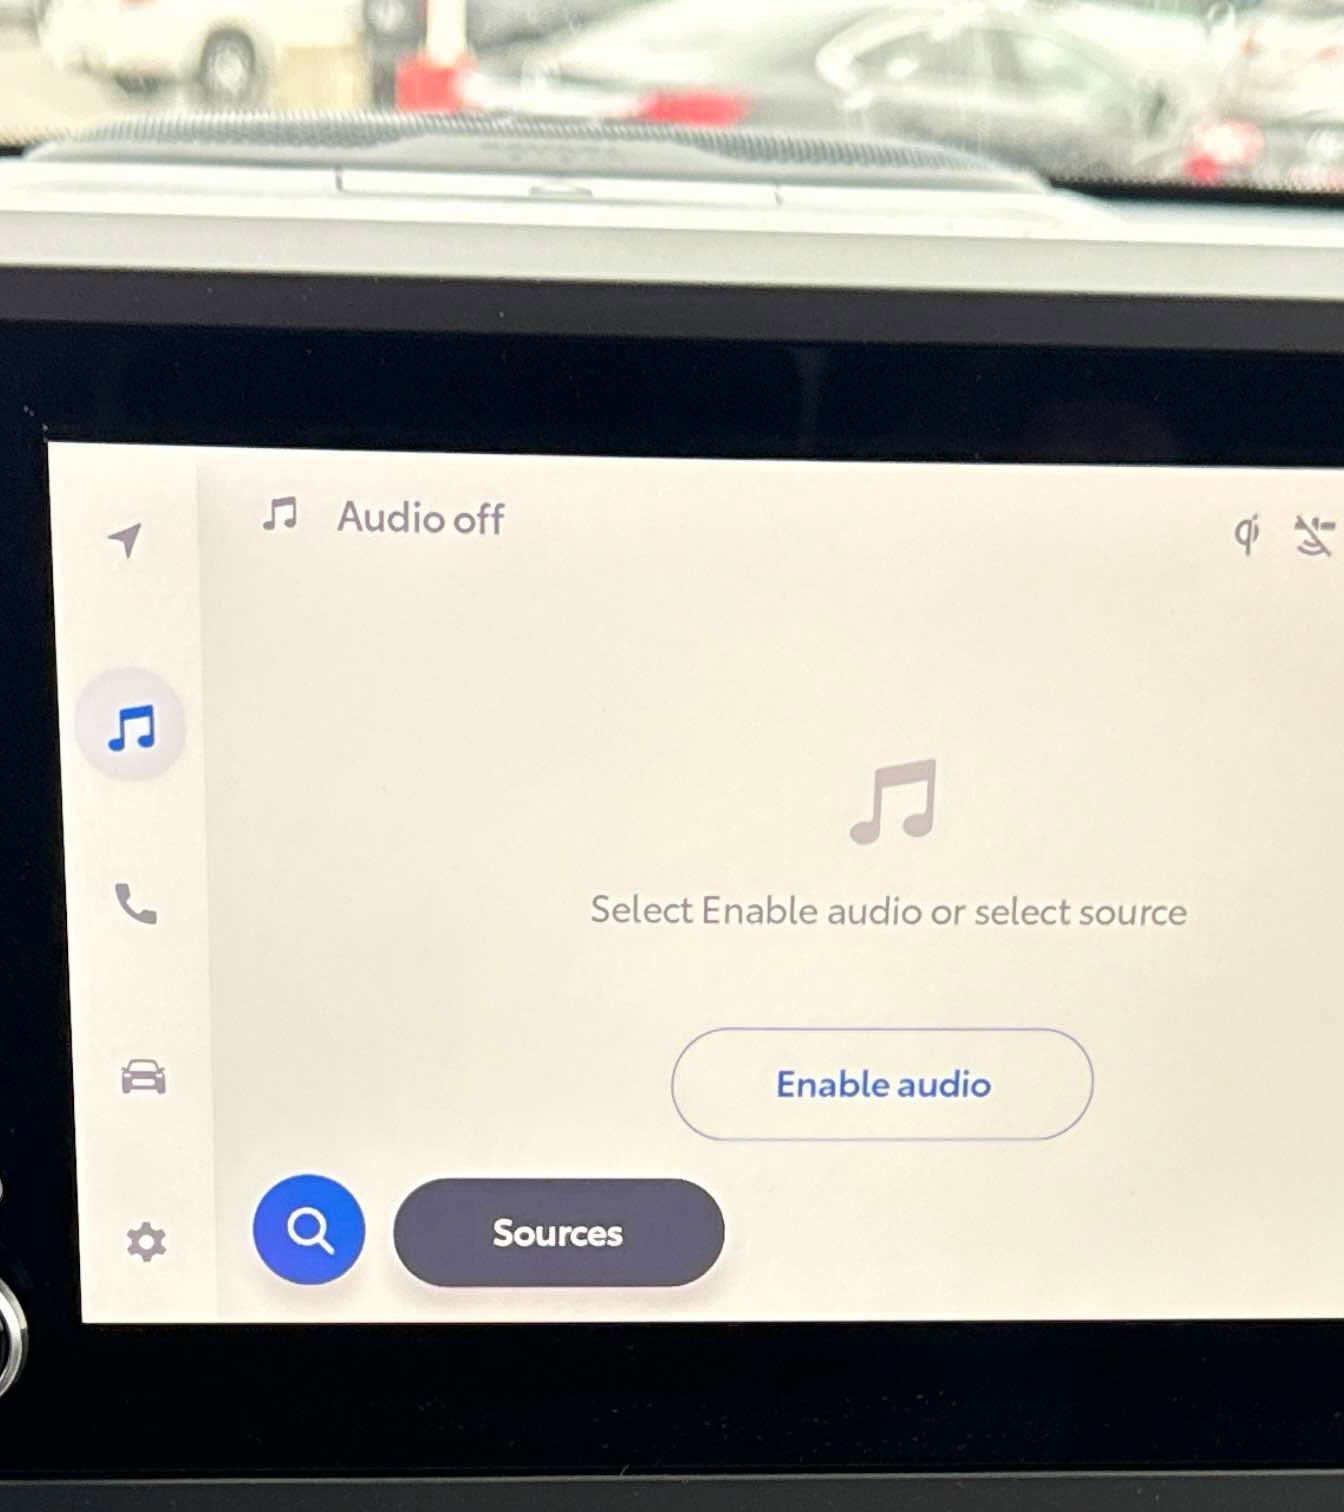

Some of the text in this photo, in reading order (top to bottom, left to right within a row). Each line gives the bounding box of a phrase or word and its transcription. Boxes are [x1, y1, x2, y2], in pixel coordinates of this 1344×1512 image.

[337, 499, 506, 535] Audio off
[591, 894, 1188, 926] Select Enable audio or select source
[777, 1070, 992, 1098] Enable audio
[493, 1218, 624, 1247] Sources
